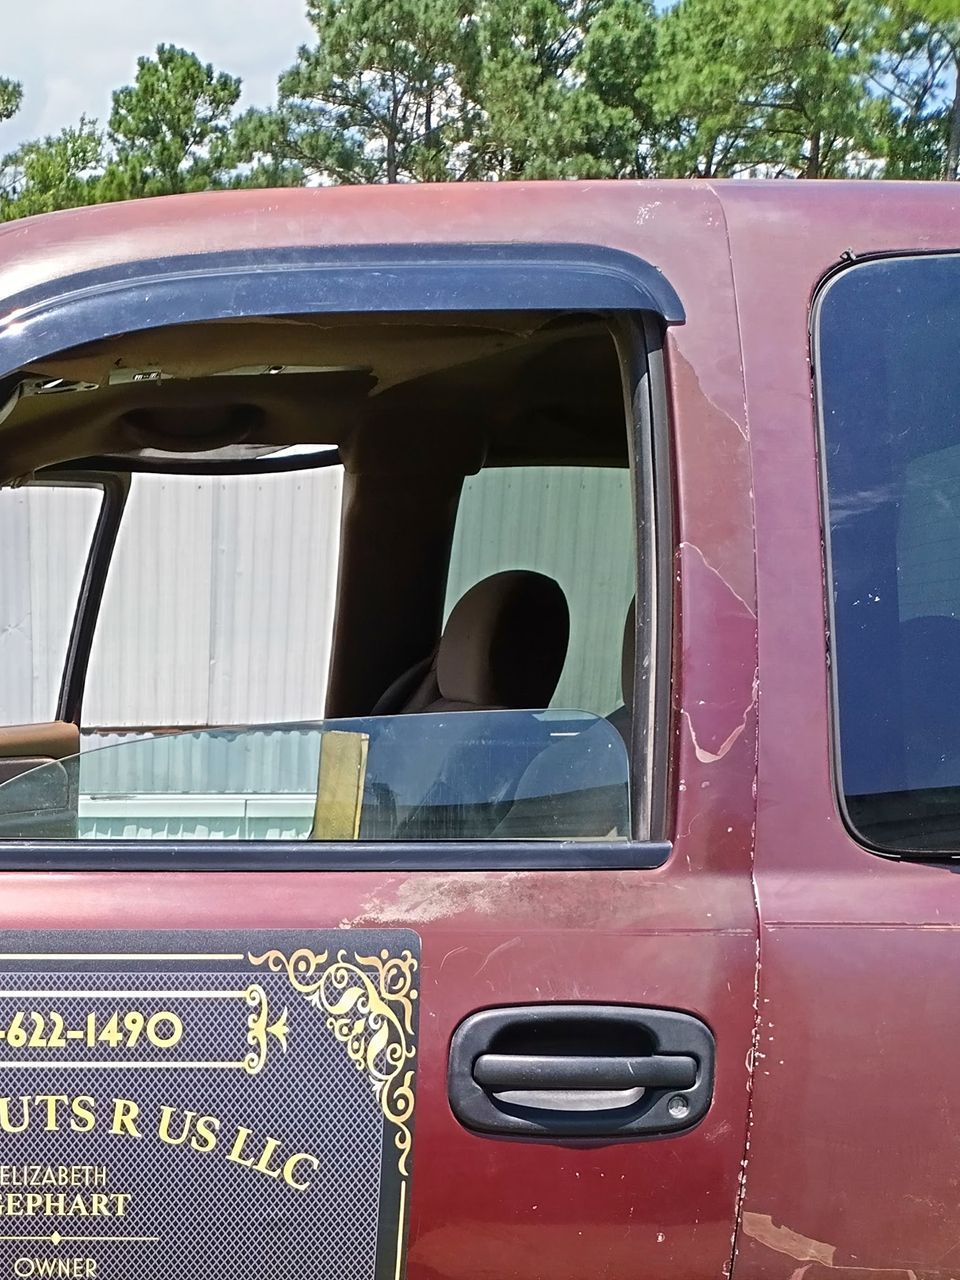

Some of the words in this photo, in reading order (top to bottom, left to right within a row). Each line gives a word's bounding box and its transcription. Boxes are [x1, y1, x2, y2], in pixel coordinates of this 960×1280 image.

[111, 1098, 142, 1138] R
[157, 1107, 221, 1154] US
[225, 1125, 322, 1192] LLC
[13, 1257, 98, 1280] OWNER
